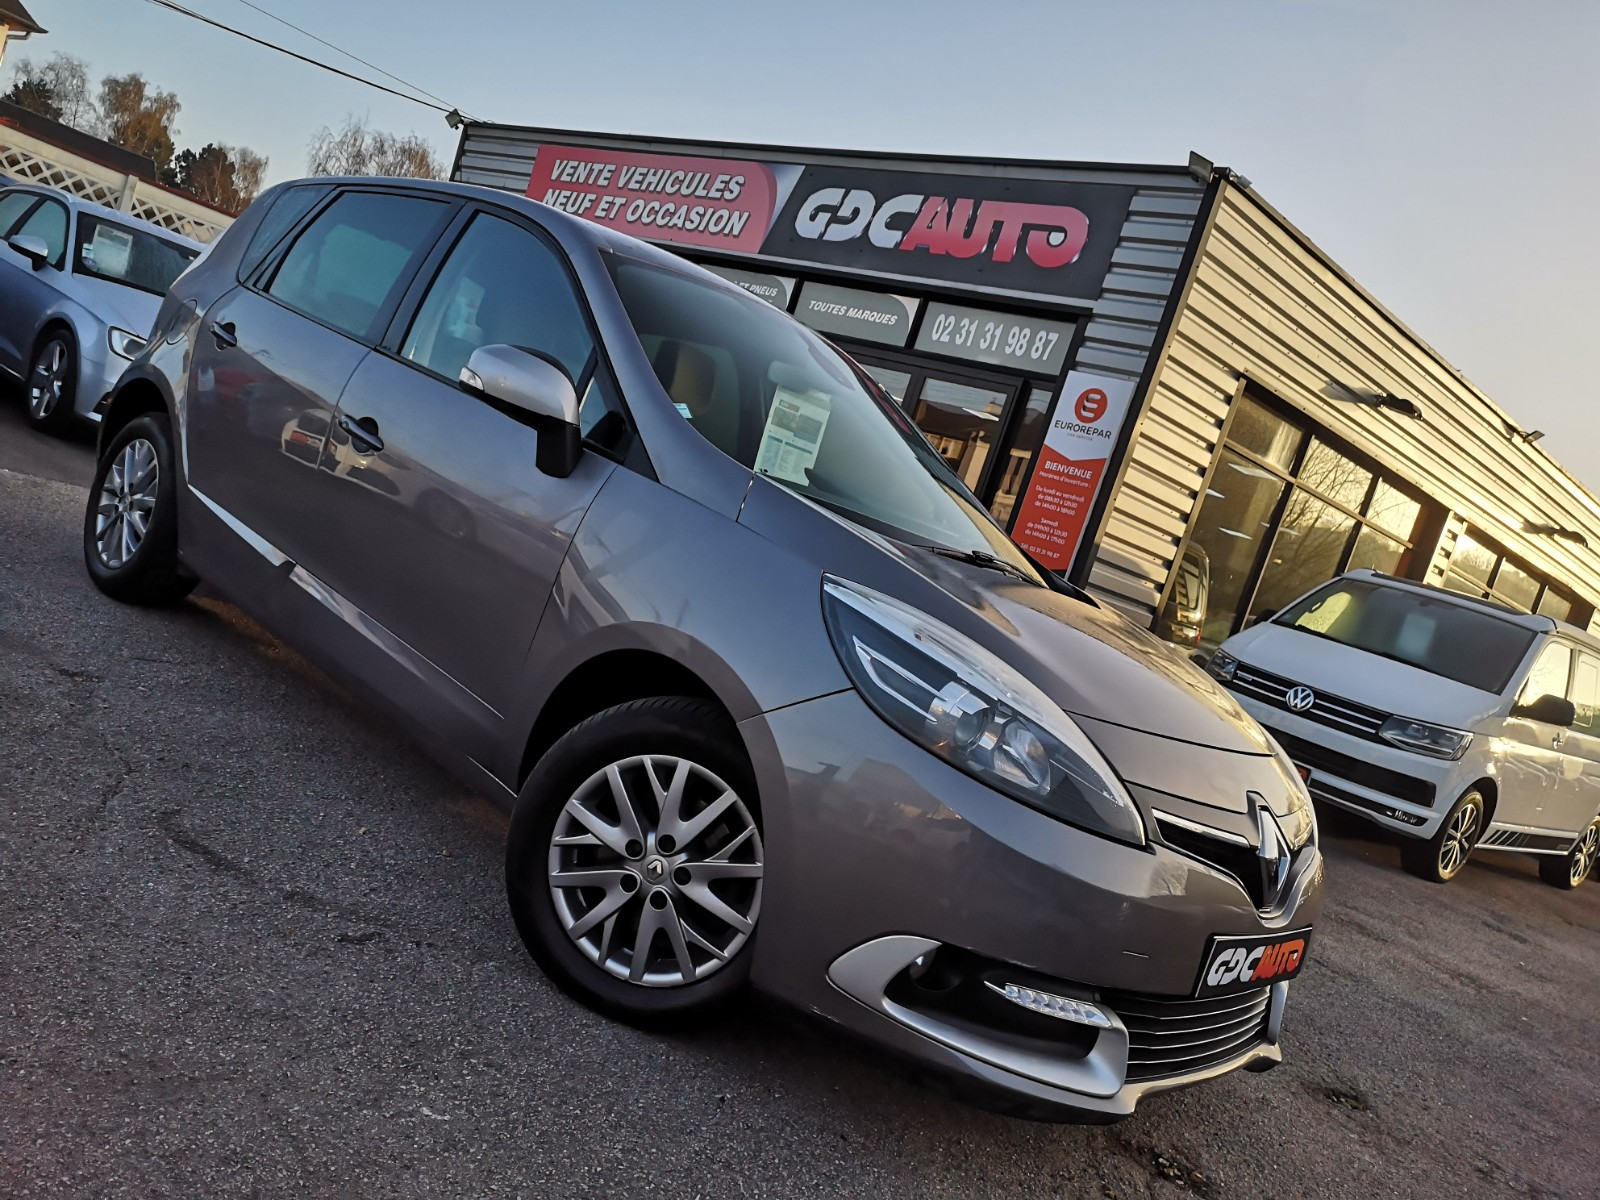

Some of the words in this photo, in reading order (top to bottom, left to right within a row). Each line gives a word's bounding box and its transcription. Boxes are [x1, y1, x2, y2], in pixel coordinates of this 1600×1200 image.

[550, 159, 617, 186] VENTE
[617, 165, 745, 200] VEHICULES
[542, 189, 597, 214] NEUF
[598, 195, 626, 220] ET
[625, 199, 750, 236] OCCASION
[749, 284, 778, 297] PNEUS
[808, 300, 847, 317] TOUTES
[846, 307, 898, 326] MARQUES
[932, 313, 954, 342] 02
[955, 317, 979, 347] 31
[979, 322, 1002, 351] 31
[1004, 326, 1031, 357] 98
[1030, 330, 1059, 361] 87
[1054, 420, 1112, 440] EUROREPAR
[1044, 460, 1093, 479] BIENVENUE
[1062, 493, 1085, 502] vendredi
[1041, 517, 1059, 527] Samedi
